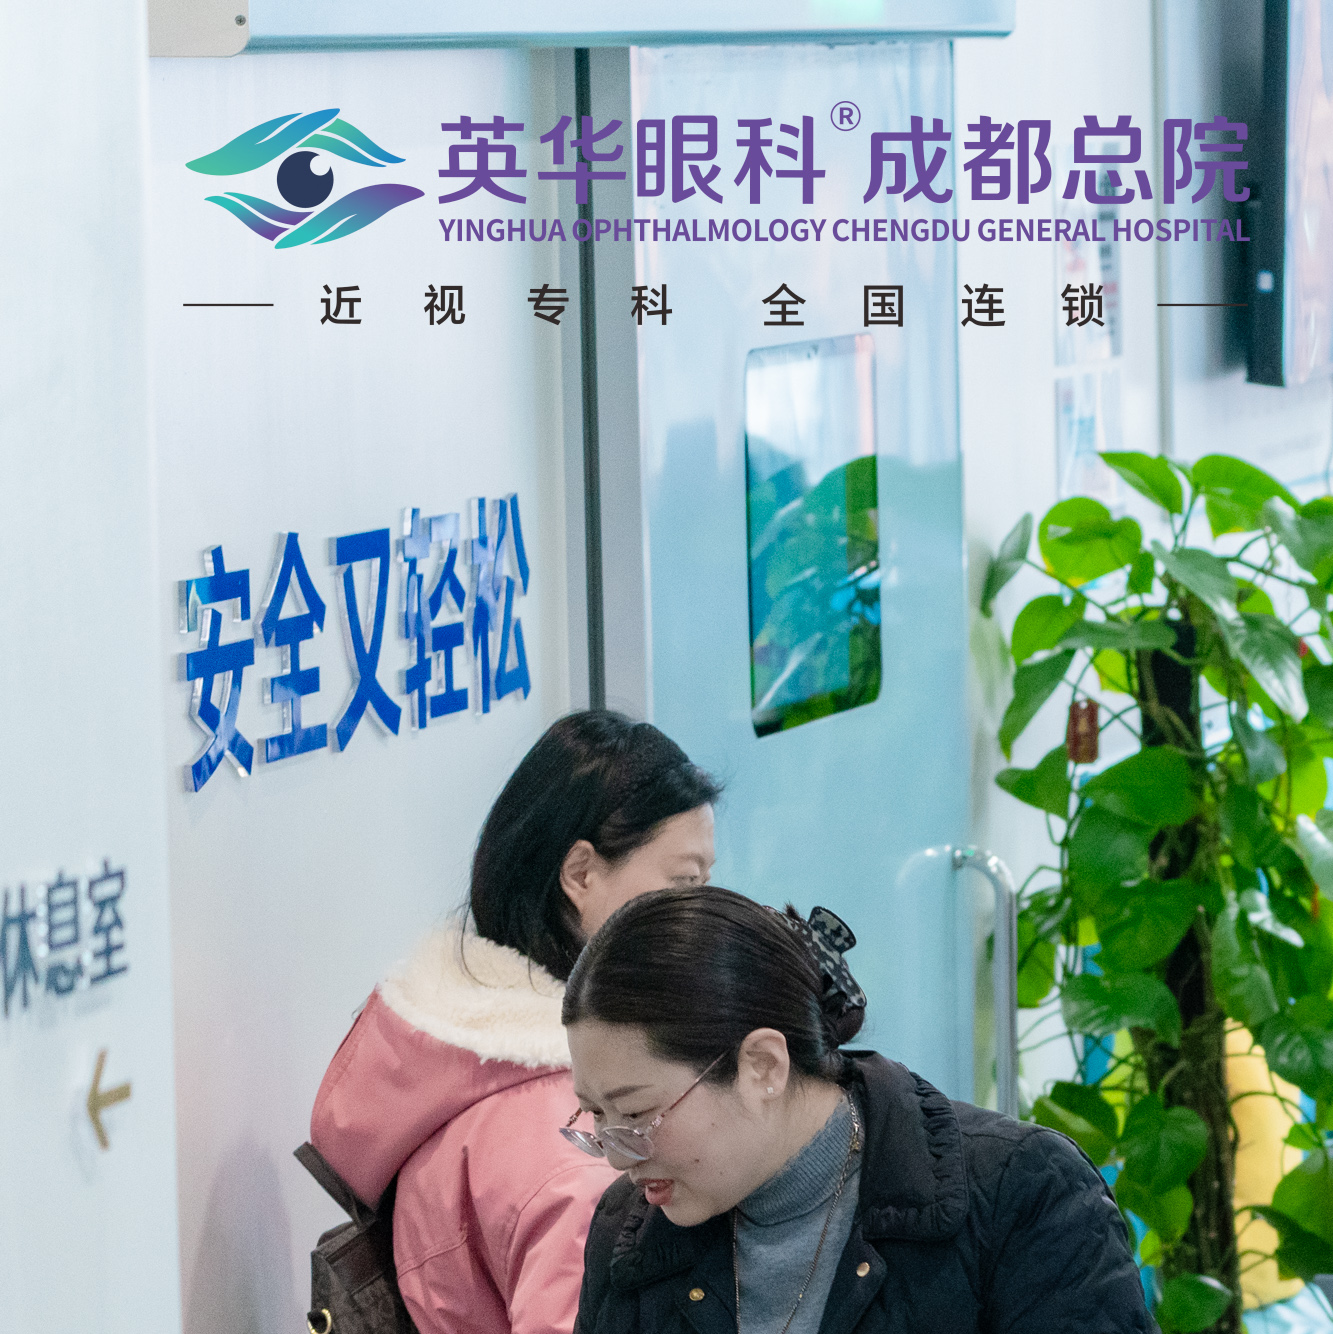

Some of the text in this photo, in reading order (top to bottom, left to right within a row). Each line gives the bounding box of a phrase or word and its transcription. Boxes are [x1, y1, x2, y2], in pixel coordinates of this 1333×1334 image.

[178, 493, 531, 793] 安全又轻松
[0, 857, 128, 1018] 休息室
